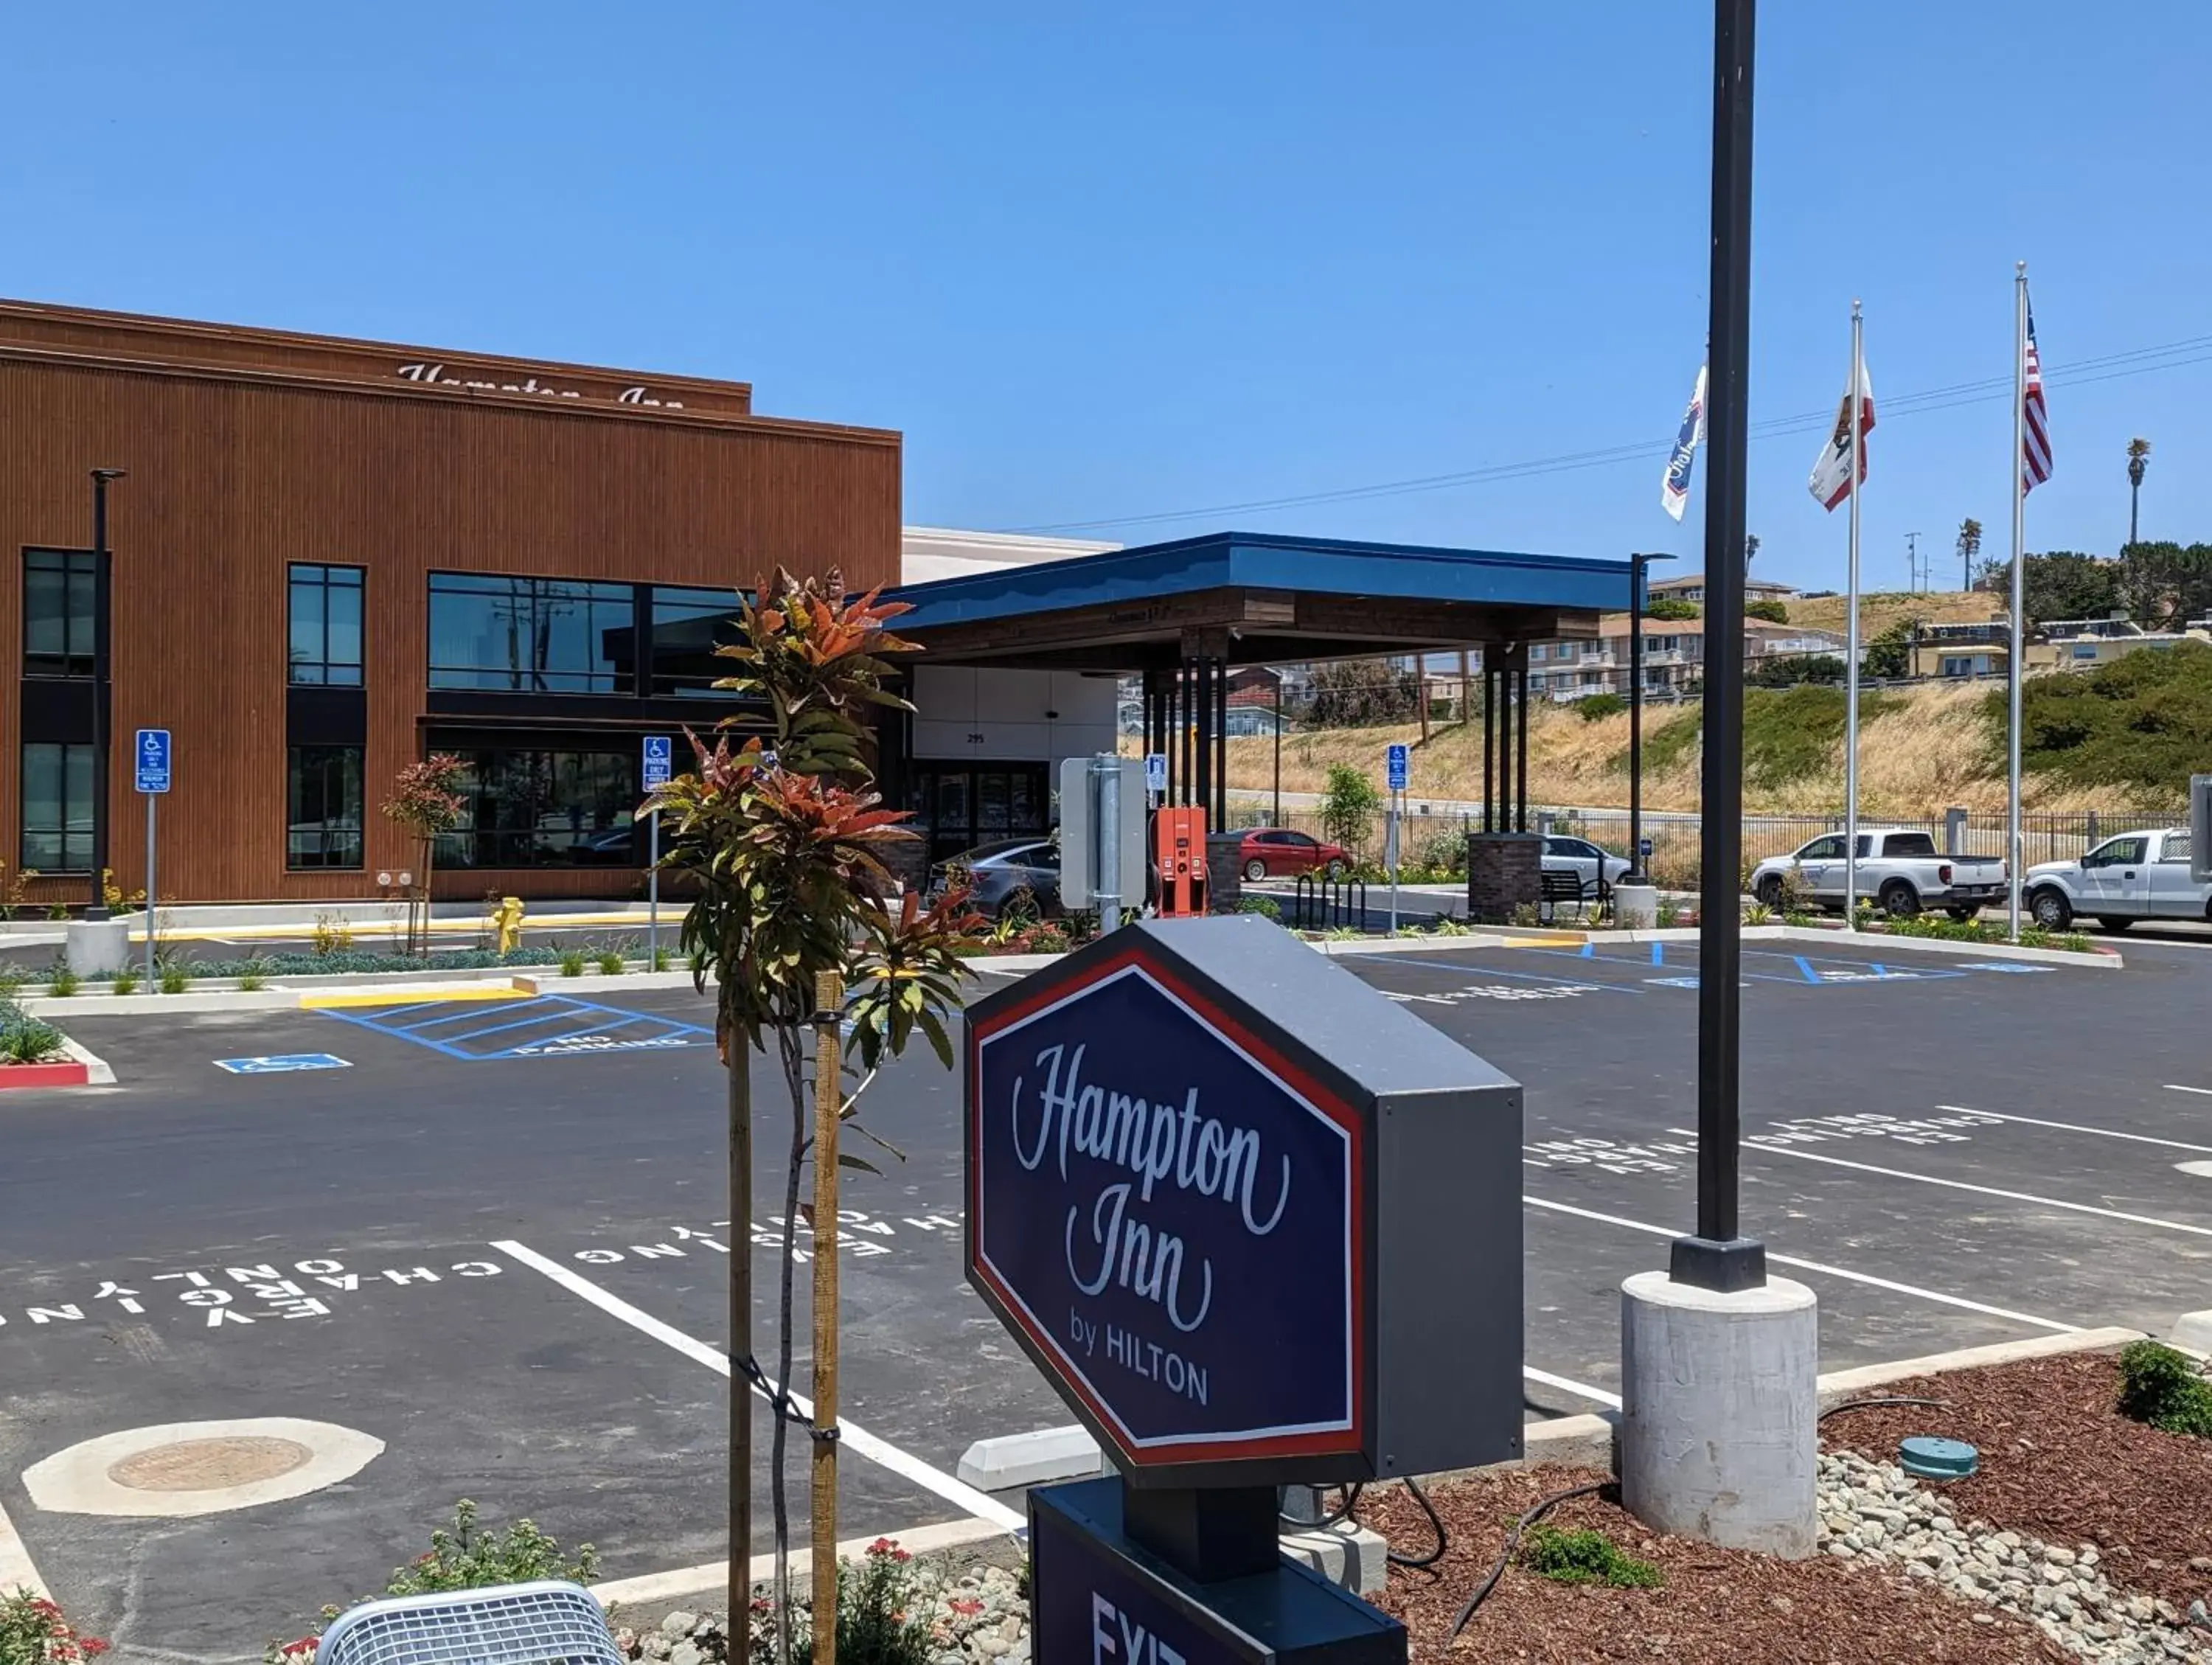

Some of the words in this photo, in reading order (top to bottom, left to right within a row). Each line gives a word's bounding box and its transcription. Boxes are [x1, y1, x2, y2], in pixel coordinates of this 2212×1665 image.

[1012, 1043, 1290, 1236] Hampton
[0, 1262, 504, 1327] CHARGIN
[94, 1259, 345, 1299] ONLY
[1065, 1183, 1213, 1332] Inn
[207, 1298, 331, 1328] EV
[1071, 1304, 1097, 1358] by
[1107, 1322, 1208, 1406] HILTON
